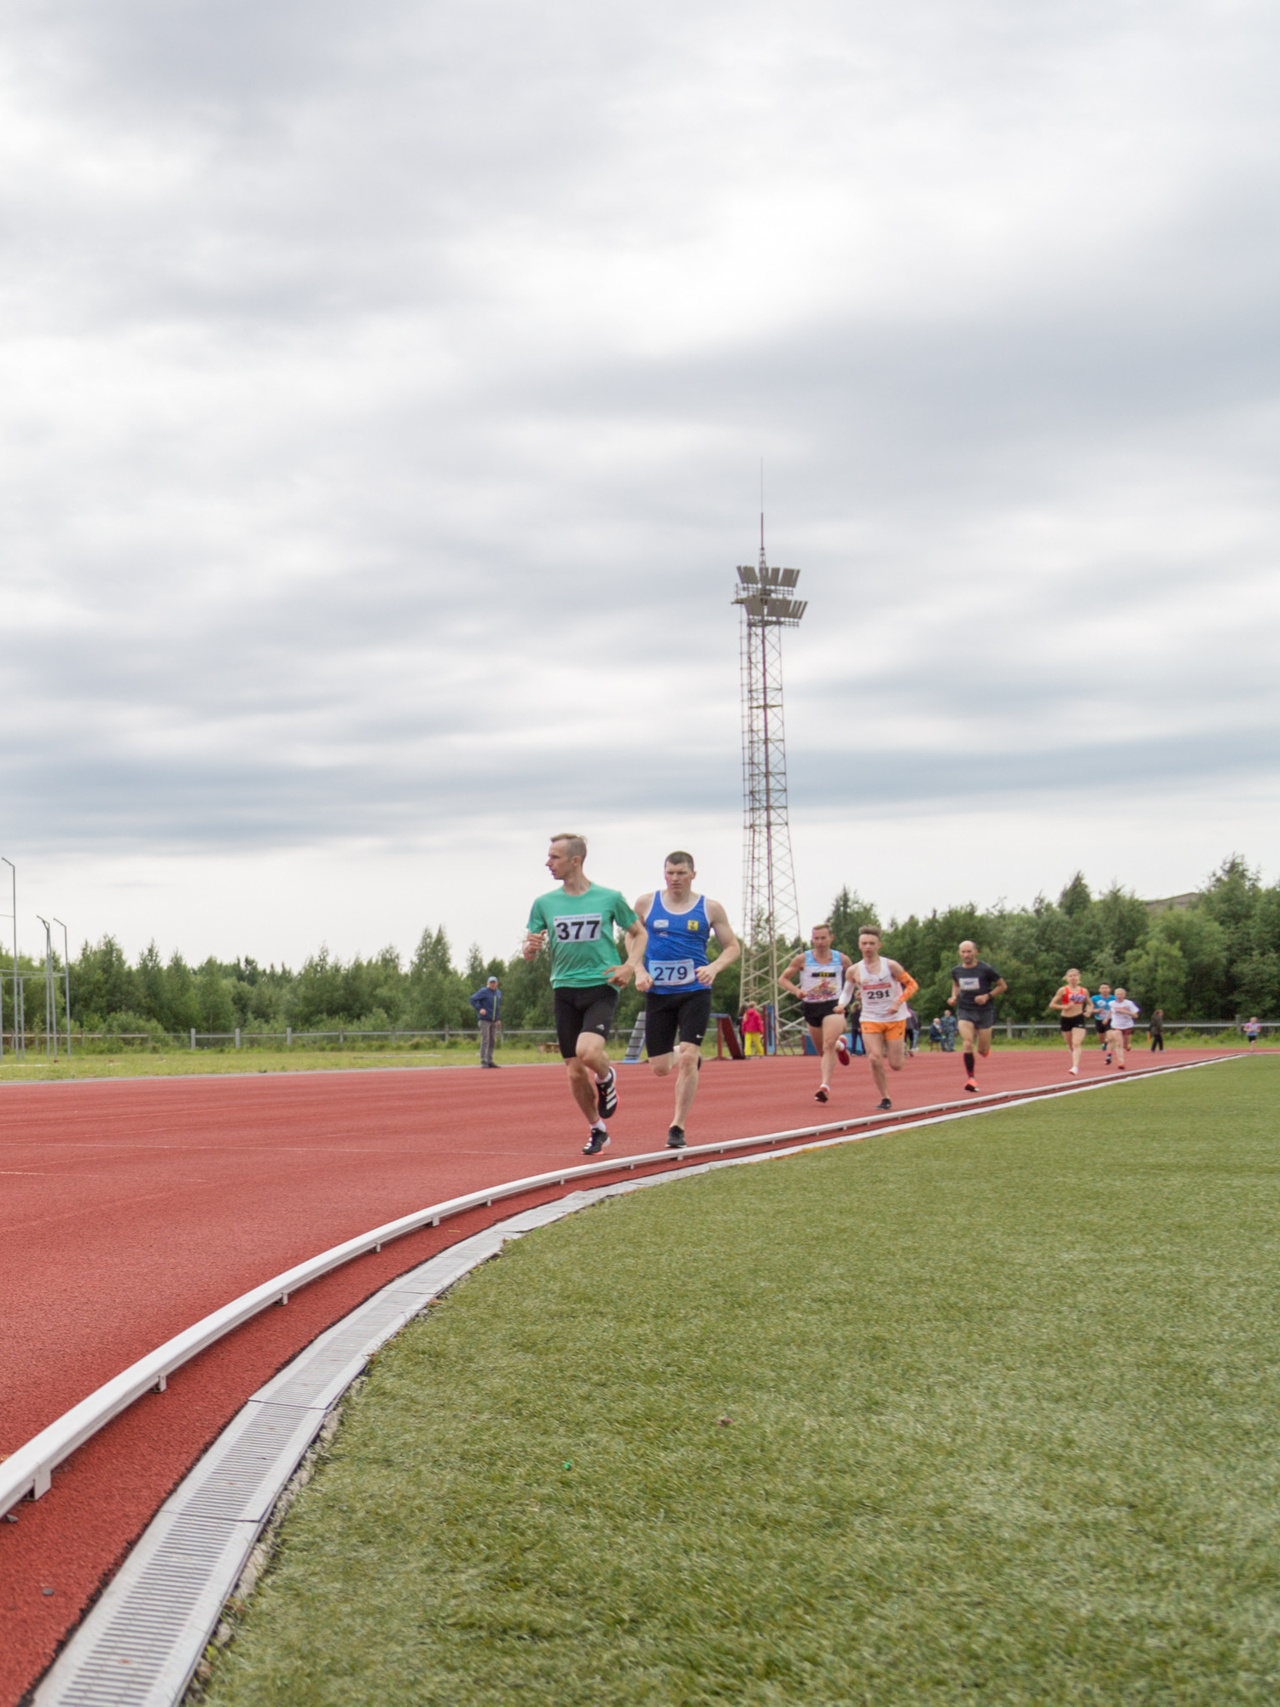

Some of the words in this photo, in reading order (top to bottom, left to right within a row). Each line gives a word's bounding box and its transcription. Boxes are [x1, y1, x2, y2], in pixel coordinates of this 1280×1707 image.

[556, 920, 600, 940] 377
[654, 966, 688, 981] 279
[867, 990, 890, 999] 291
